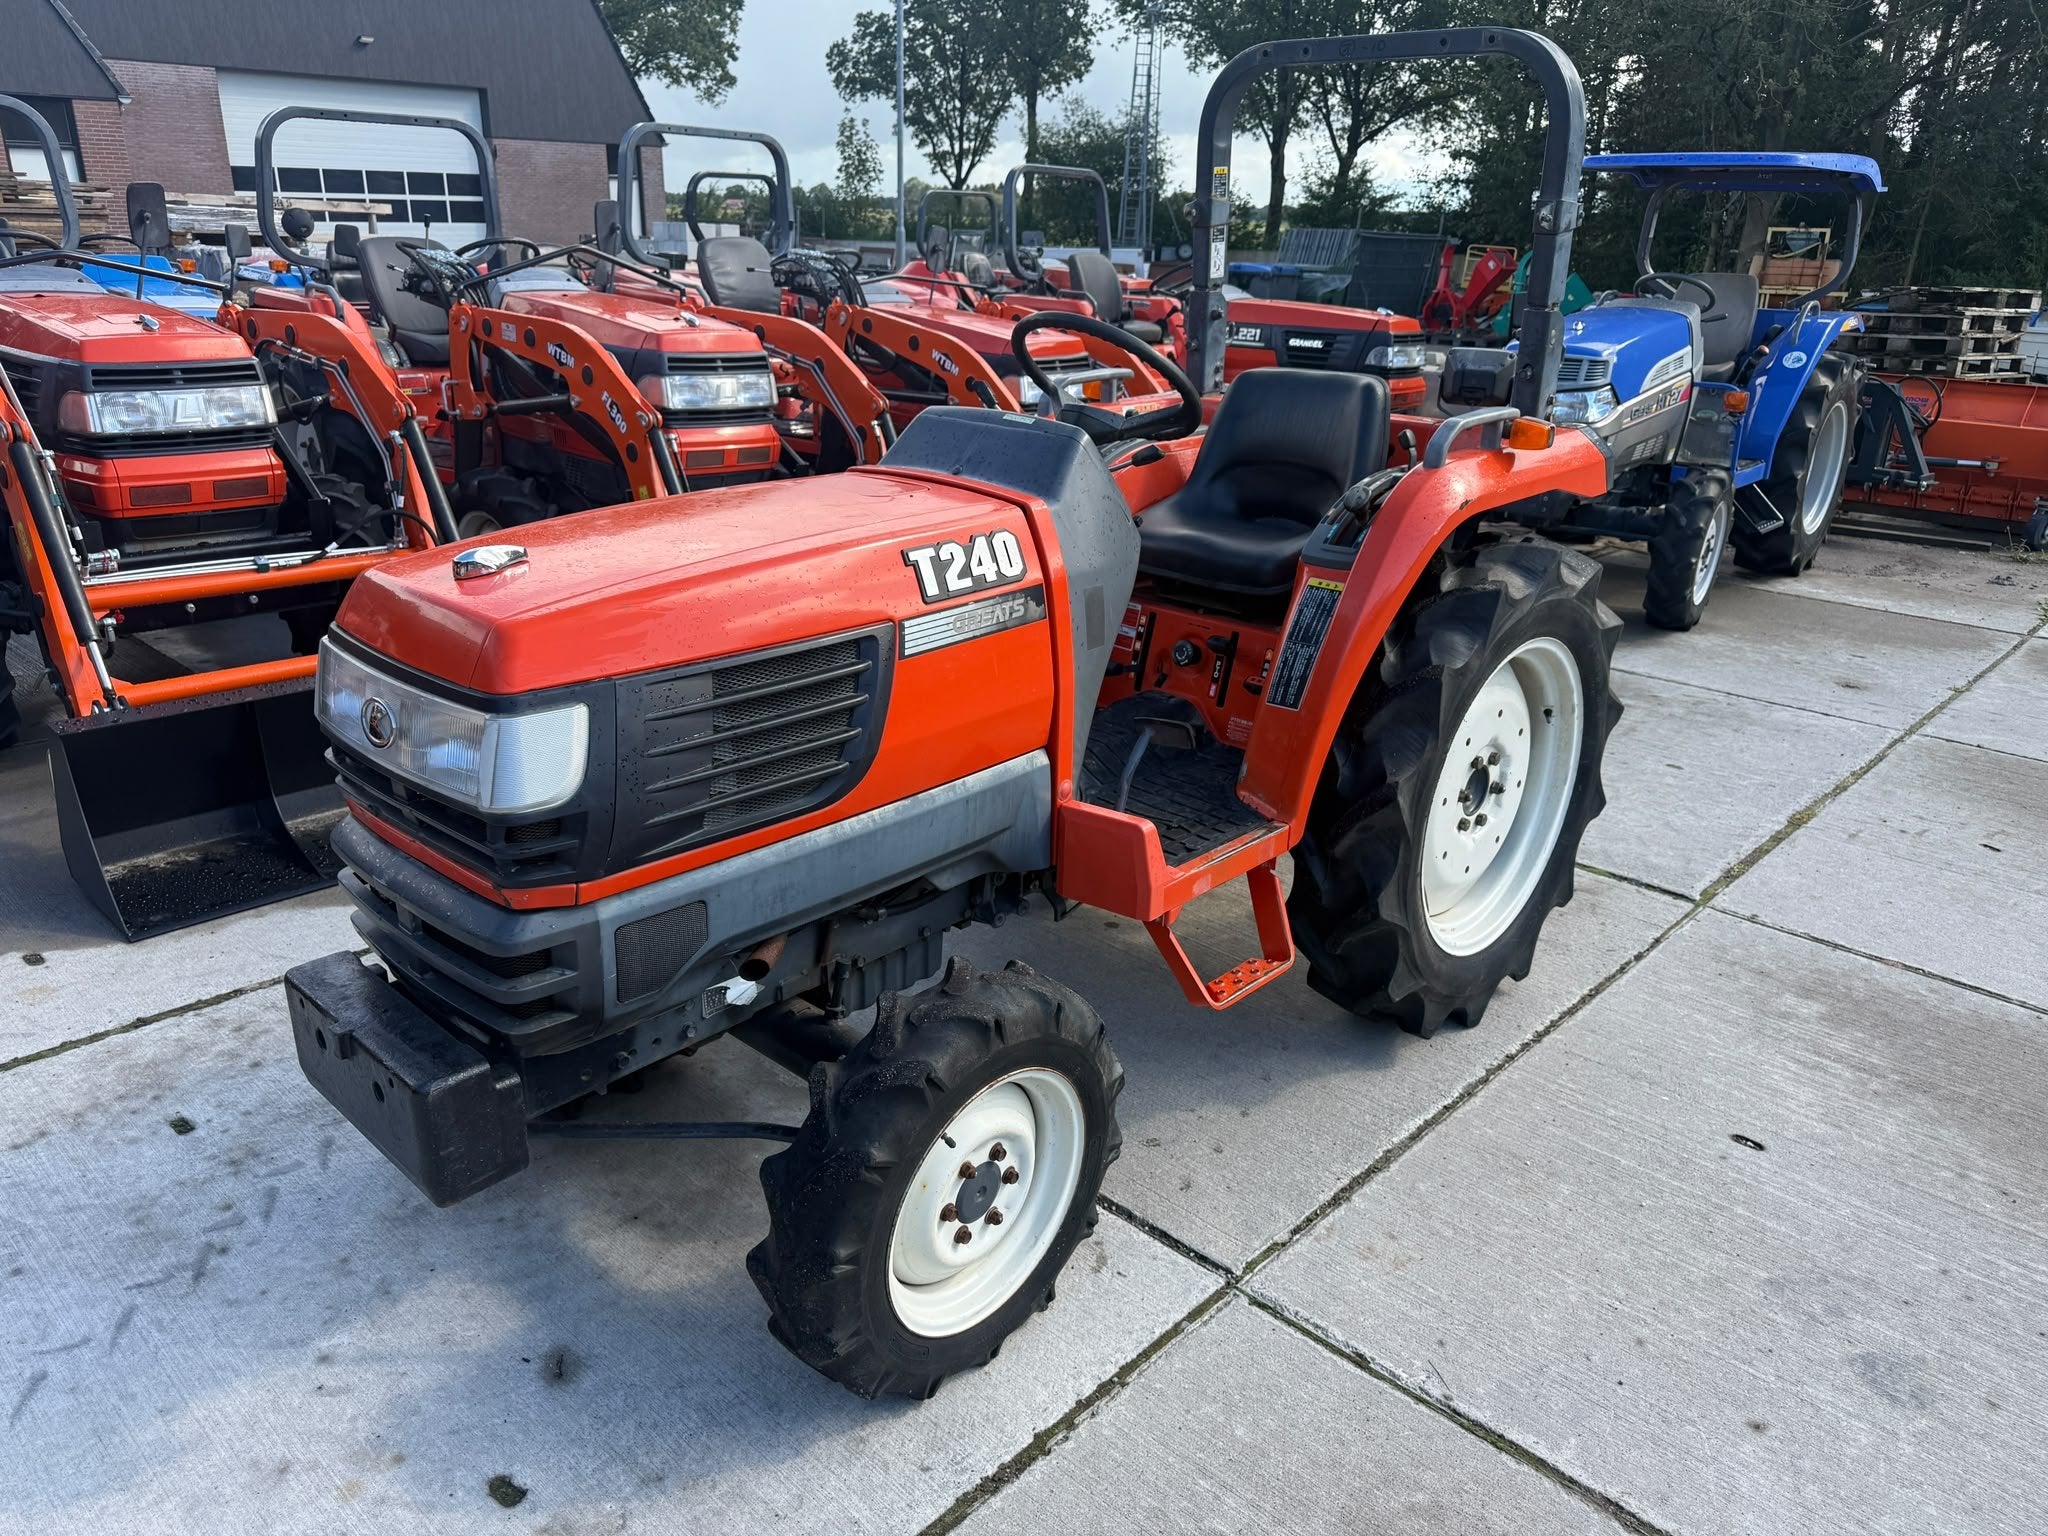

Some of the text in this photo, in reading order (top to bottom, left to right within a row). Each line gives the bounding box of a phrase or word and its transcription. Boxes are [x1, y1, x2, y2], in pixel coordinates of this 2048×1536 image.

[547, 341, 575, 369] WTBM
[931, 348, 960, 377] WTBM
[601, 390, 627, 434] FL300
[907, 530, 1024, 597] T240
[952, 597, 1026, 634] GREATS
